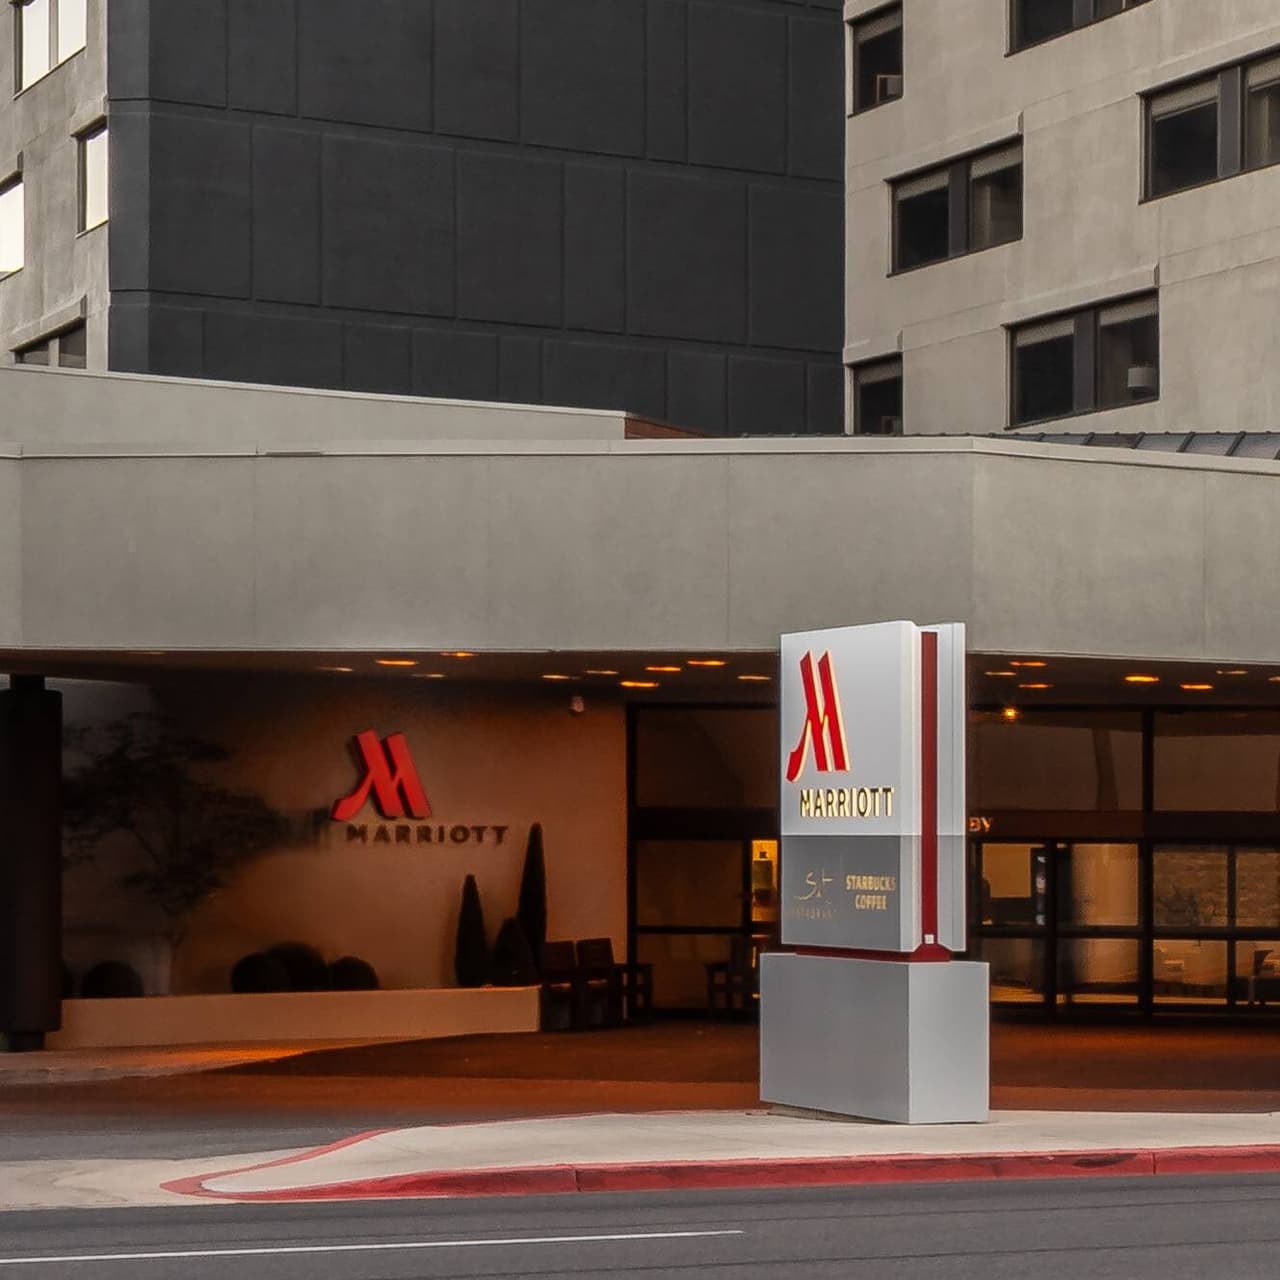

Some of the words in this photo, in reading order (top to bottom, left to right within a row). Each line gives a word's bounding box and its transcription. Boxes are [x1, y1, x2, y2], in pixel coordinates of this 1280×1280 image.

[799, 787, 895, 817] MARRIOTT
[346, 824, 509, 845] MARRIOTT
[846, 873, 897, 892] STARBUCKS
[855, 893, 888, 911] COFFEE
